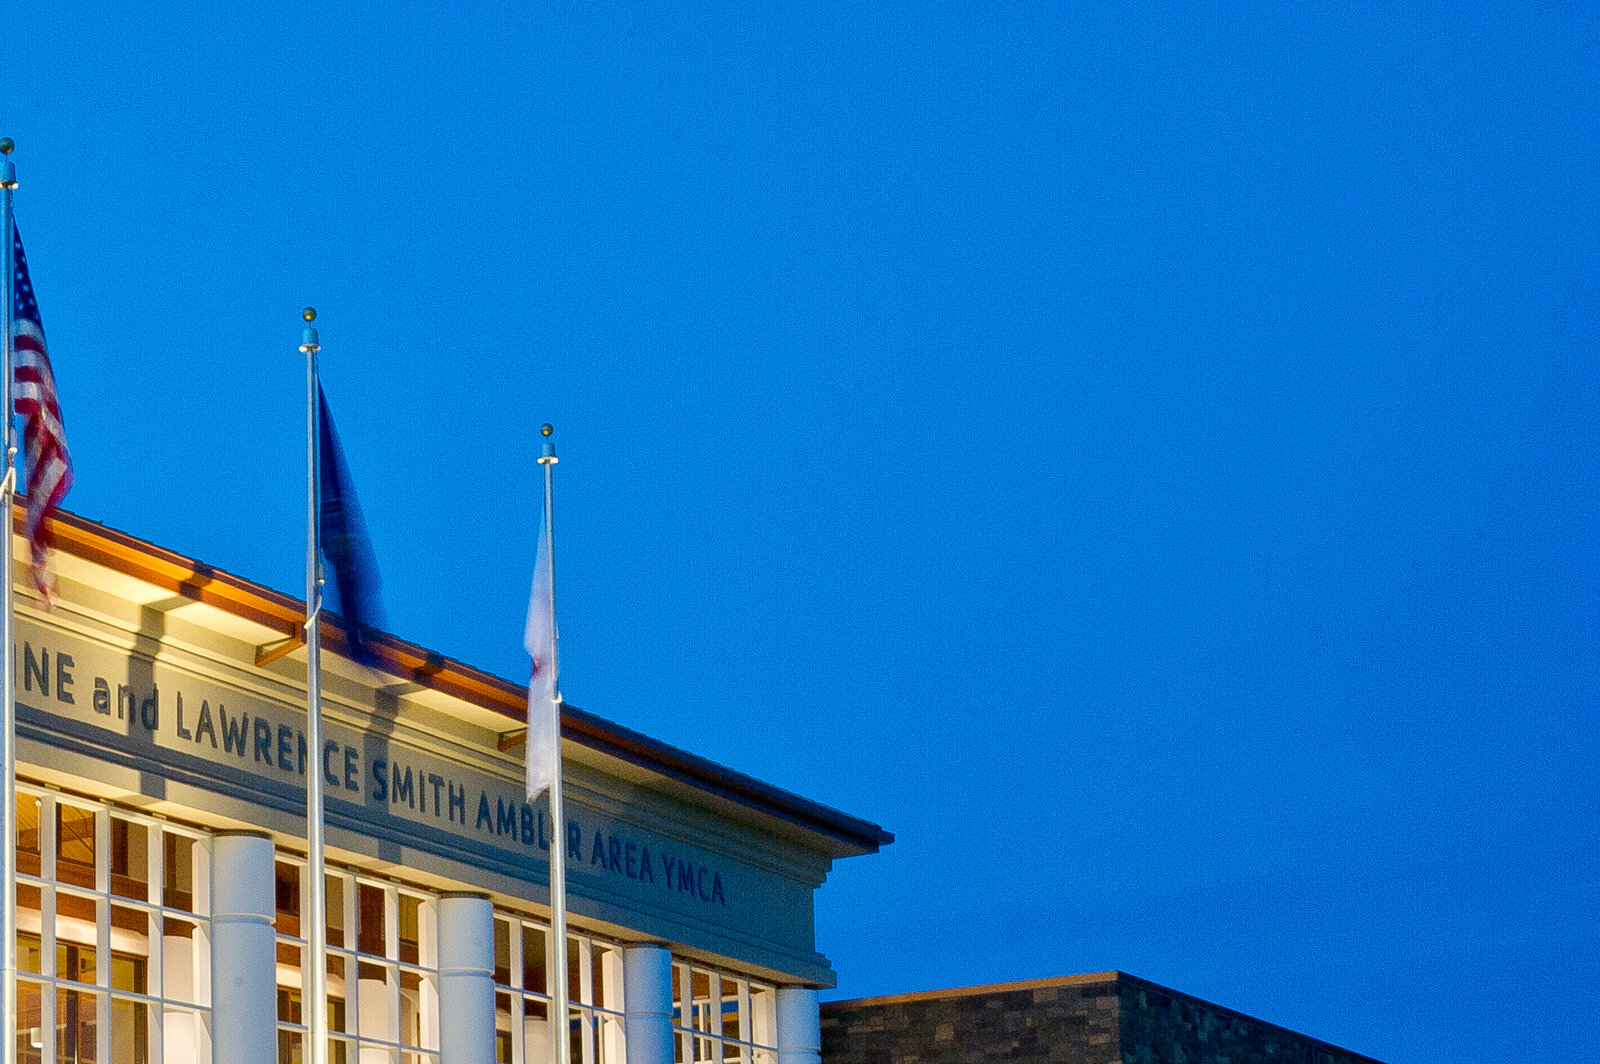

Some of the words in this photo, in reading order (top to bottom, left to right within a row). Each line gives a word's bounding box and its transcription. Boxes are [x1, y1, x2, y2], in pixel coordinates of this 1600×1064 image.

[92, 675, 160, 731] and
[372, 757, 466, 825] SMITH
[475, 790, 582, 861] AMBLR
[591, 831, 655, 884] AREA
[661, 853, 726, 905] YMCA
